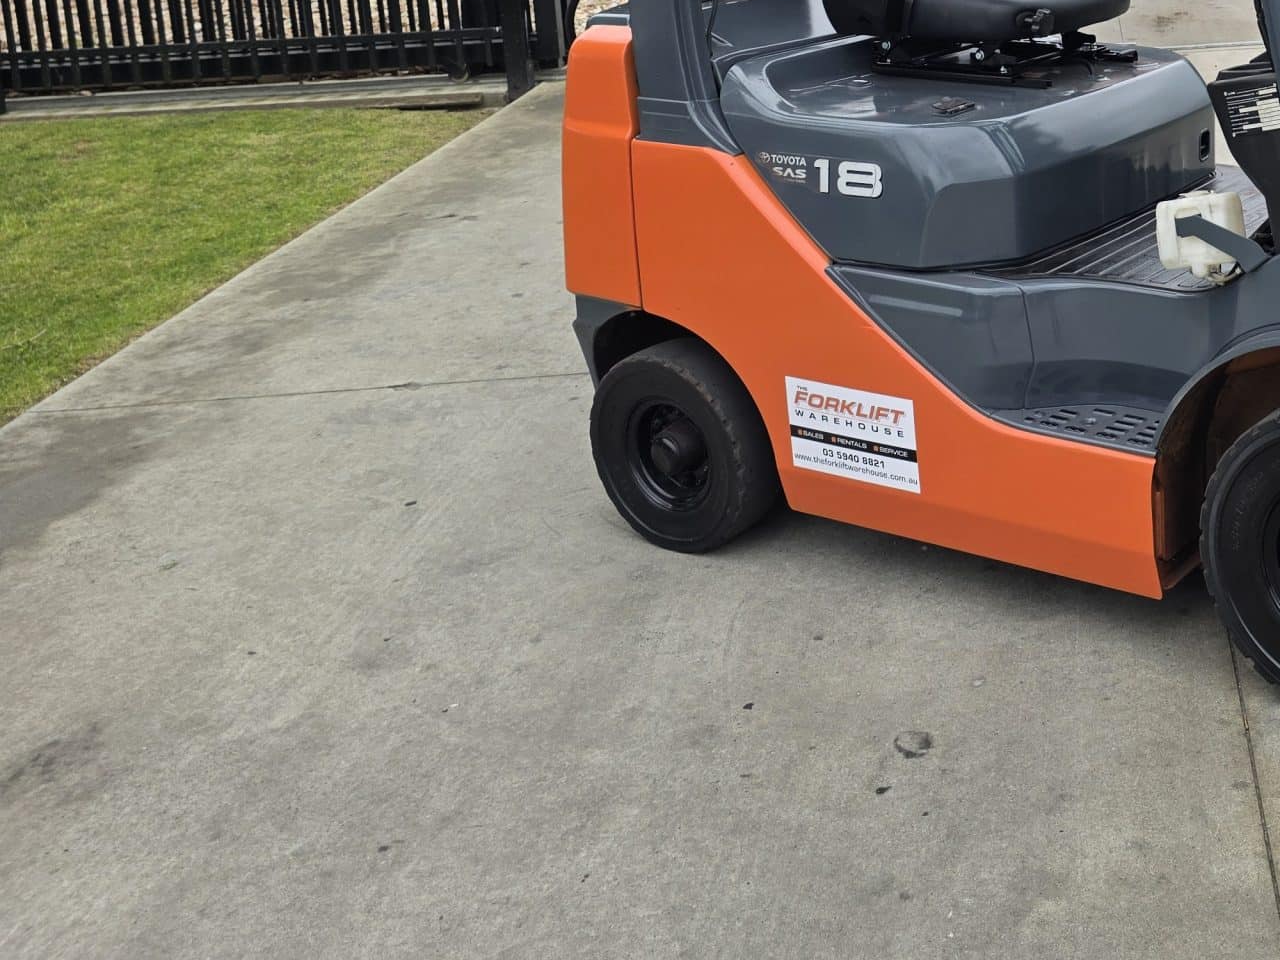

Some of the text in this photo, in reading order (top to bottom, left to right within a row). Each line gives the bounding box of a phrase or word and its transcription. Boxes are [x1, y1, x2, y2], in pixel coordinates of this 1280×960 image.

[770, 154, 807, 167] TOYOTA
[772, 166, 807, 179] SAS
[813, 158, 883, 198] 18
[794, 390, 905, 424] FORKLIFT
[795, 409, 905, 438] WAREHOUSE
[803, 430, 908, 457] SALES RENTALS SERVICE
[822, 448, 834, 458] 03
